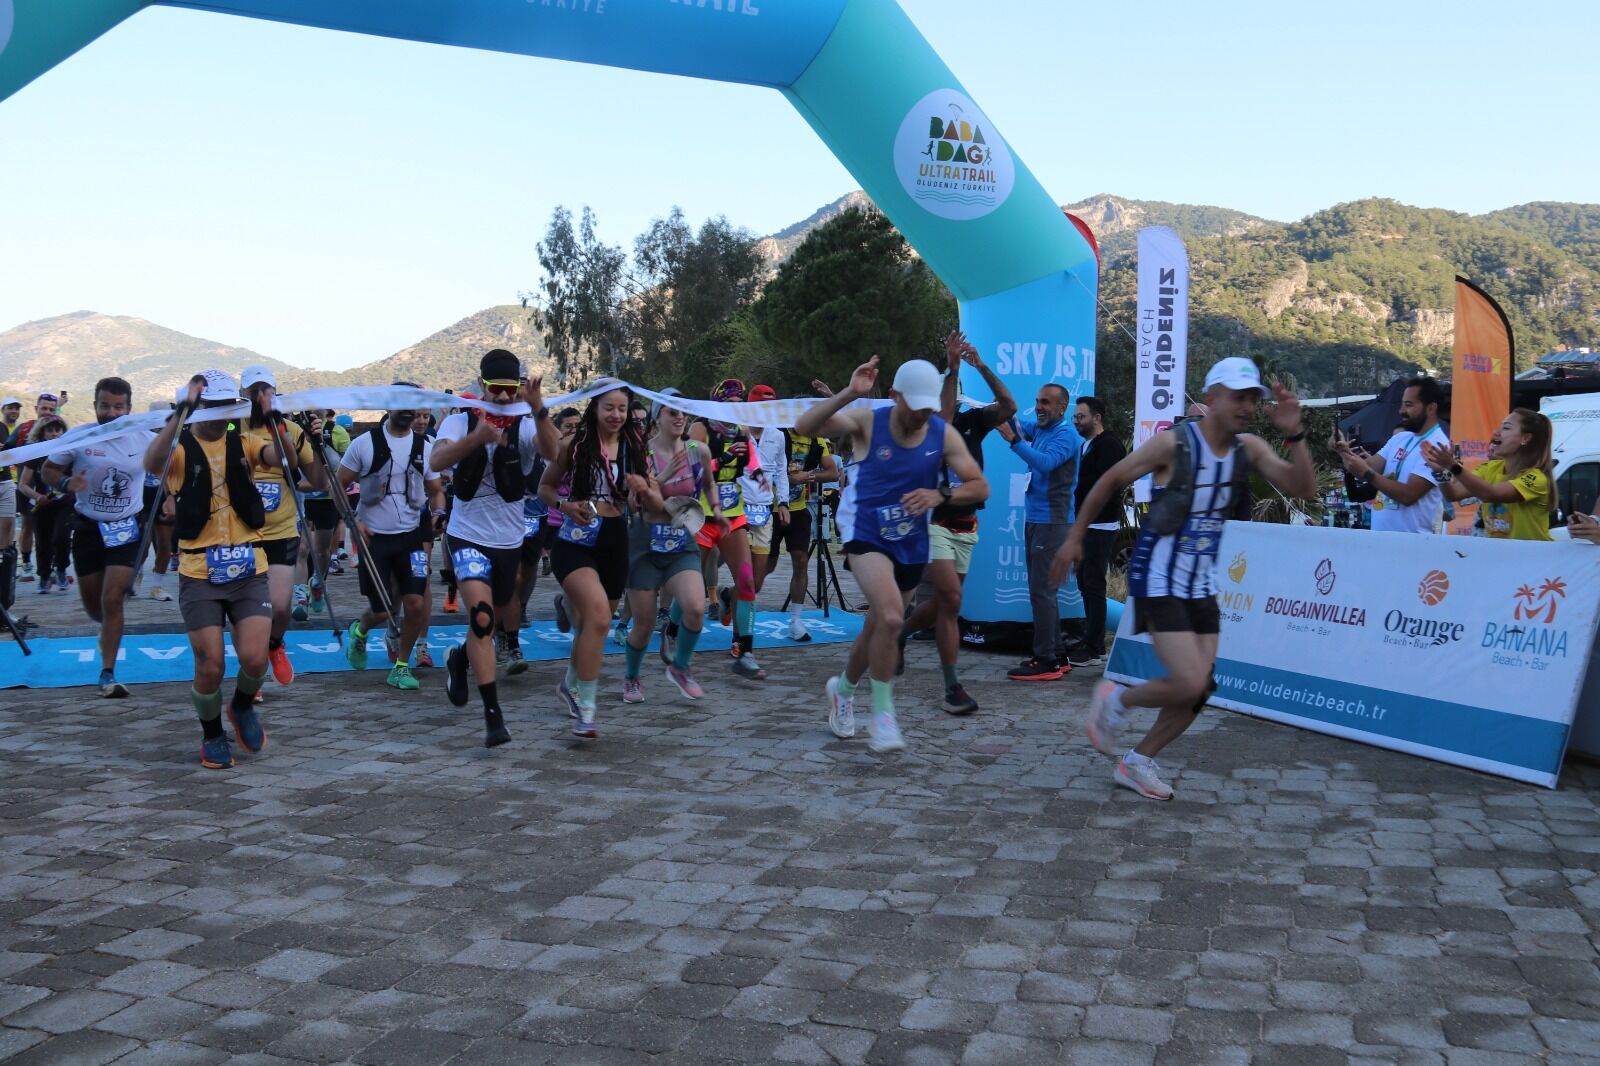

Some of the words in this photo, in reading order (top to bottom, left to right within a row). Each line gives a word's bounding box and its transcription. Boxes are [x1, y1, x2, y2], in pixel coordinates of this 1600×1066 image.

[929, 116, 986, 145] BABA
[919, 163, 997, 183] ULTRATRAIL
[996, 342, 1047, 376] SKY
[255, 482, 280, 494] 525
[89, 495, 131, 507] BELGRADE
[211, 545, 249, 561] 1567
[1217, 592, 1253, 611] MON
[1231, 612, 1244, 622] Bar
[1265, 597, 1366, 627] BOUGAINVILLEA
[1286, 622, 1310, 633] Beach
[1317, 626, 1332, 636] Bar
[1384, 609, 1465, 646] Orange
[1481, 621, 1568, 658] BANANA
[1491, 651, 1523, 667] Beach
[1531, 657, 1550, 671] Bar
[1214, 673, 1387, 721] www.oludenizbeach.tr
